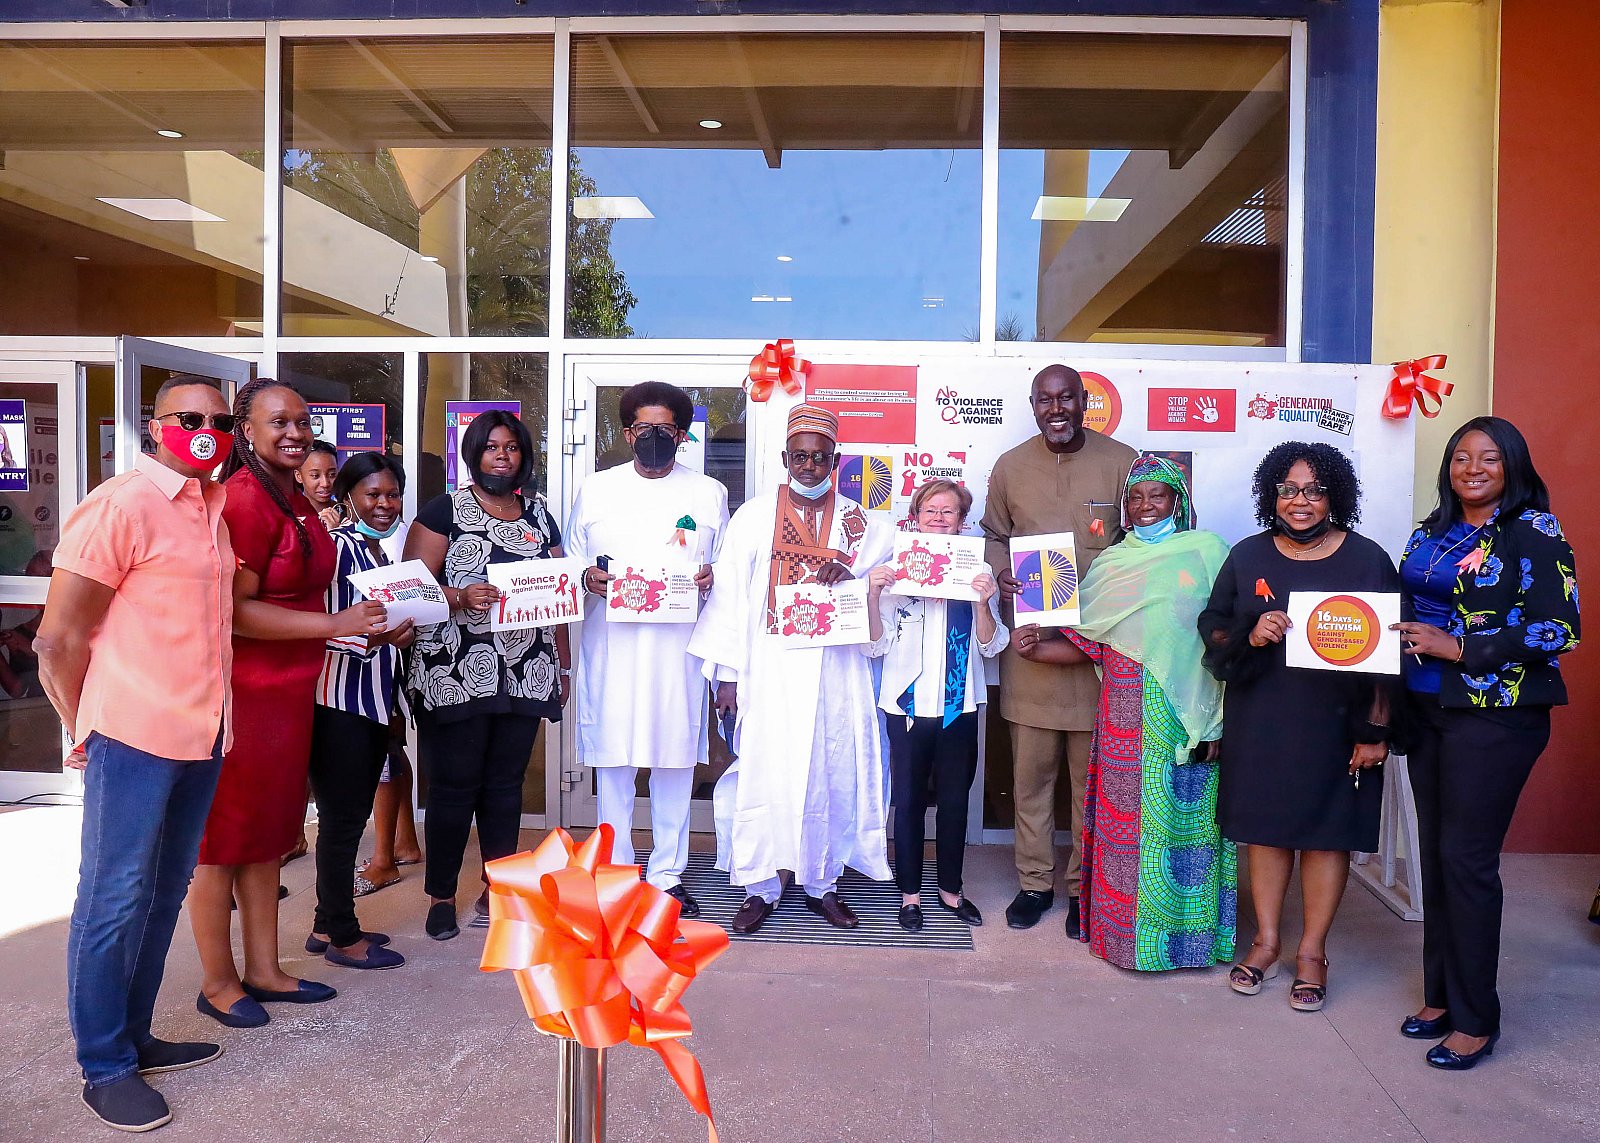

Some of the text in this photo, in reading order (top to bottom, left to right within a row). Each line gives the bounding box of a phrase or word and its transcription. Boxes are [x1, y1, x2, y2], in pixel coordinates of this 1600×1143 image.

[937, 398, 1003, 407] TO VIOLENCE
[1168, 396, 1189, 406] STOP
[1279, 396, 1333, 410] GENERATION
[958, 407, 1003, 415] AGAINST
[1278, 409, 1321, 422] EQUALITY
[1323, 408, 1350, 420] STANDS
[962, 416, 1003, 424] WOMEN
[1320, 419, 1345, 431] RAPE
[1322, 413, 1352, 426] AGAINST
[904, 452, 933, 467] NO
[850, 474, 862, 482] 16
[510, 575, 555, 586] Violence
[1028, 572, 1041, 581] 16
[386, 577, 423, 592] GENERATION
[511, 583, 557, 595] against Women
[393, 587, 423, 601] EQUALITY
[1317, 610, 1331, 622] 16
[1317, 623, 1362, 632] ACTIVISM
[1317, 637, 1365, 645] GENDER-BASED
[1317, 642, 1349, 650] VIOLENCE
